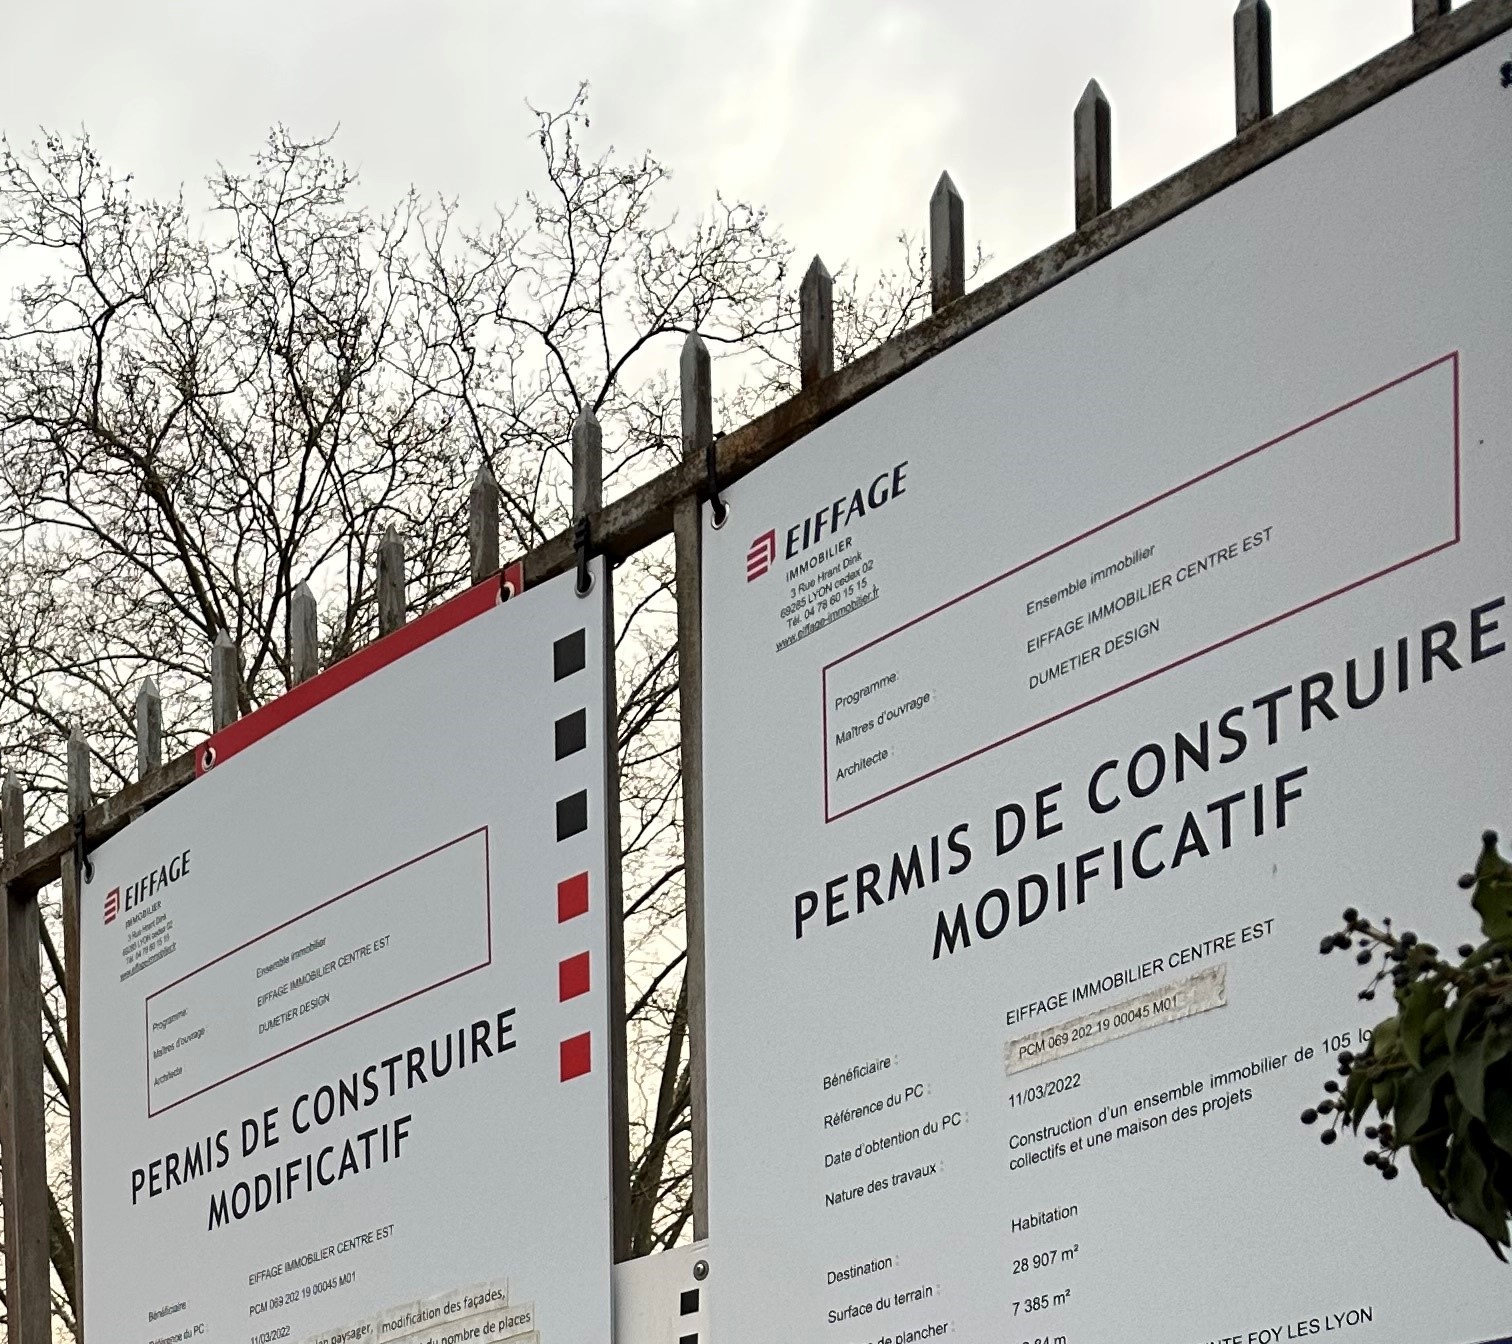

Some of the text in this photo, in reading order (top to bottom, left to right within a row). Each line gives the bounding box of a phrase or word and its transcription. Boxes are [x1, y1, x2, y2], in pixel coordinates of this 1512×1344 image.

[785, 460, 909, 561] EIFFAGE
[786, 537, 852, 583] IMMOBILIER
[1026, 544, 1156, 616] Ensemble immobilier
[1027, 526, 1273, 654] EIFFAGE IMMOBILIER CENTRE EST
[794, 596, 1506, 940] PERMIS DE CONSTRUIRE
[124, 848, 191, 913] EIFFAGE
[932, 765, 1308, 961] MODIFICATIF
[131, 1007, 517, 1206] PERMIS DE CONSTRUIRE
[1008, 1072, 1081, 1108] 11/03/2022
[207, 1114, 412, 1232] MODIFICATIF
[1011, 1205, 1078, 1233] Habitation
[248, 1223, 395, 1286] EIFFAGE IMMOBILIER CENTRE EST
[382, 1306, 441, 1333] modification
[443, 1301, 462, 1316] des
[464, 1288, 506, 1309] façades,
[482, 1322, 496, 1335] de
[498, 1312, 531, 1332] places
[1287, 1318, 1321, 1340] LES
[1325, 1306, 1373, 1331] LYON
